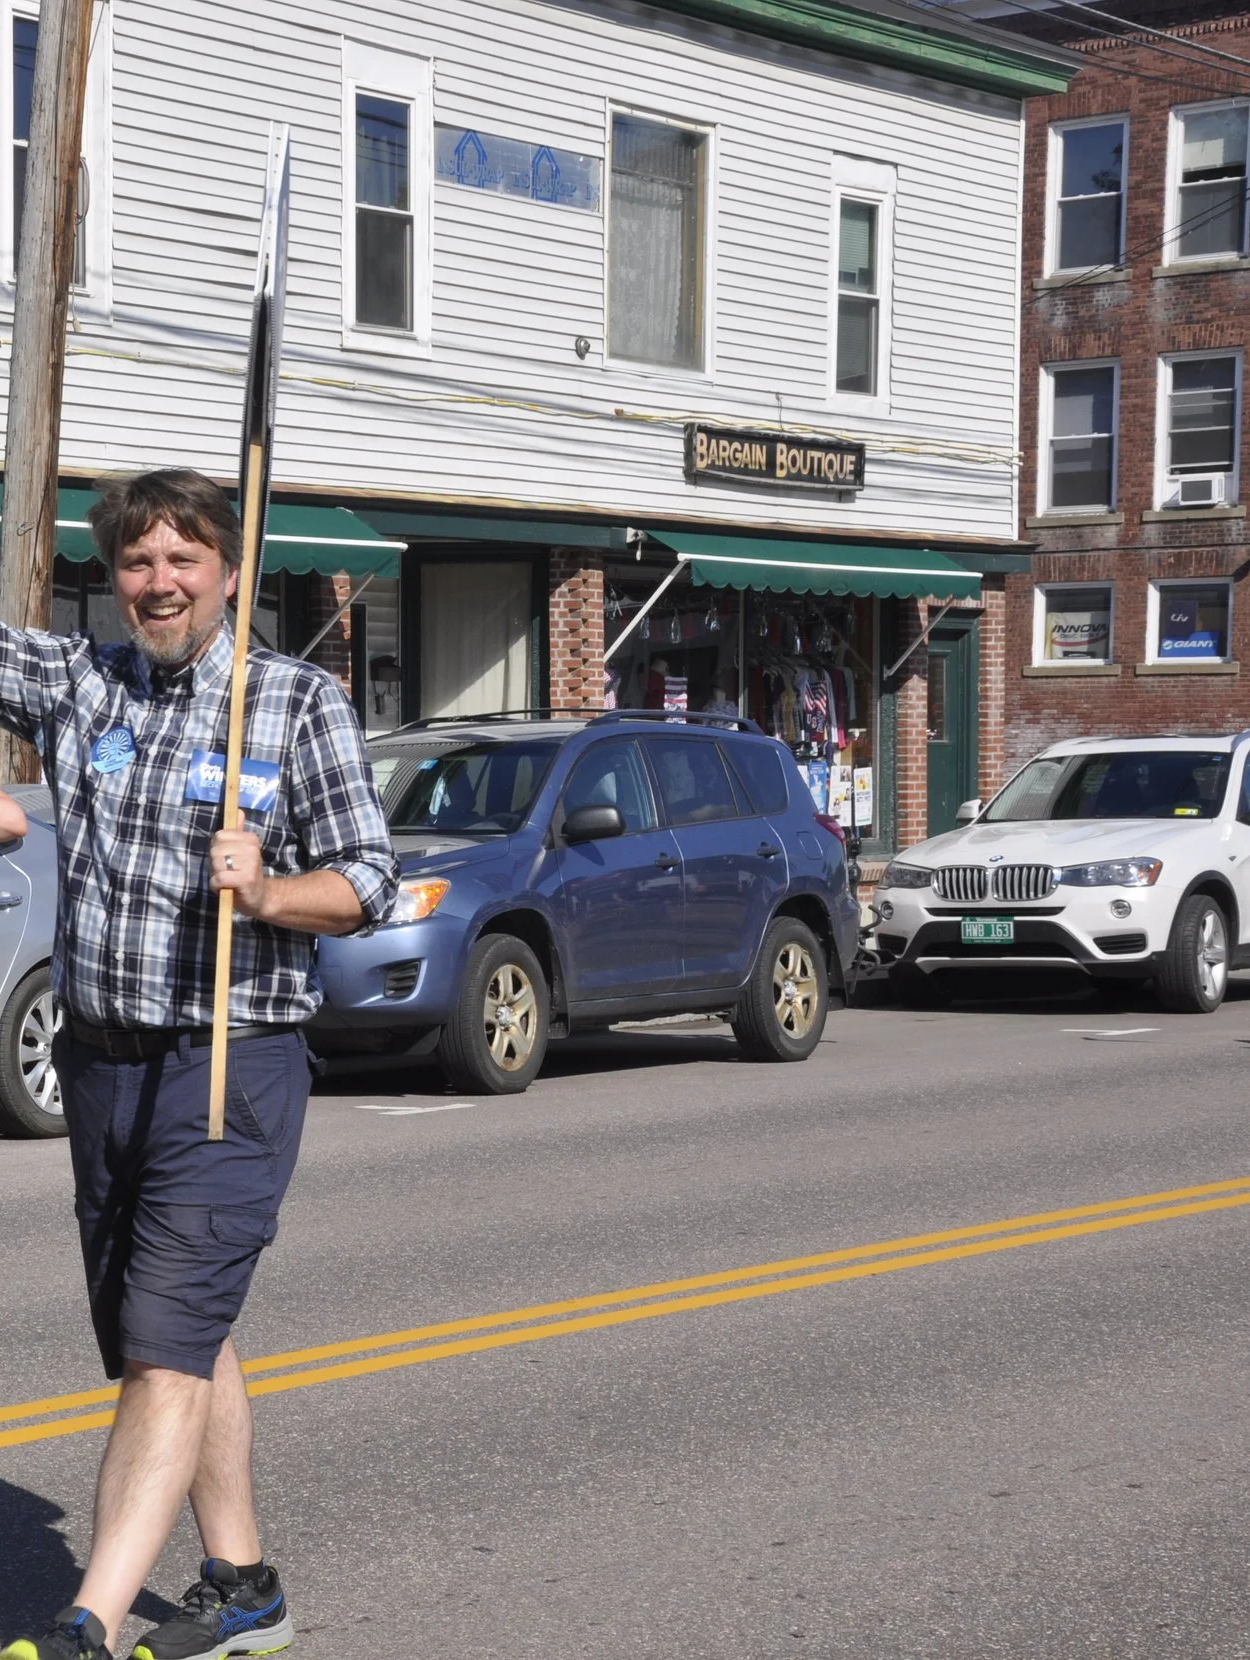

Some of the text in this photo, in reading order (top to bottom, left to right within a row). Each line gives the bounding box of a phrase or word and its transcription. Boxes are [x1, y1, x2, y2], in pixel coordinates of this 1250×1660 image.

[696, 432, 856, 482] BARGAIN BOUTIQUE
[1174, 640, 1215, 648] GIANT
[990, 923, 1009, 937] 163
